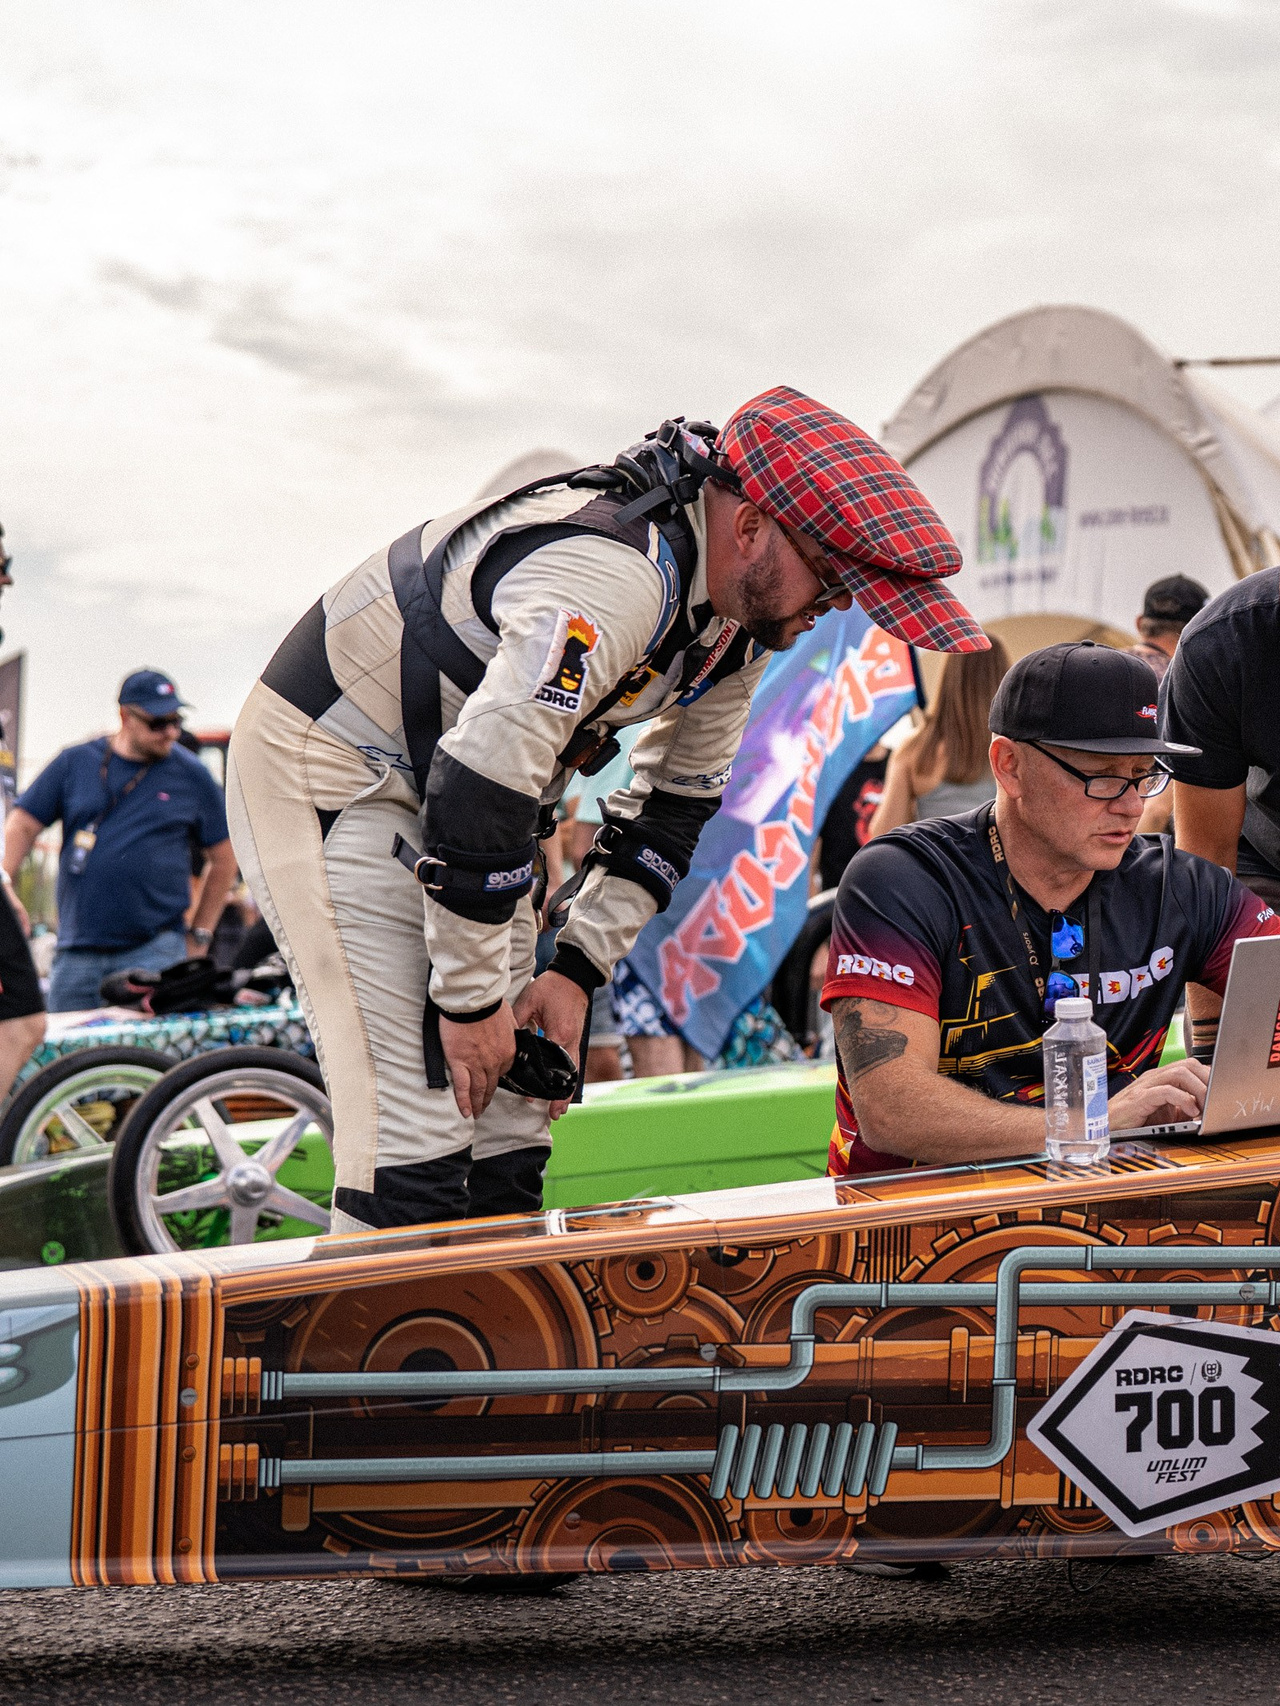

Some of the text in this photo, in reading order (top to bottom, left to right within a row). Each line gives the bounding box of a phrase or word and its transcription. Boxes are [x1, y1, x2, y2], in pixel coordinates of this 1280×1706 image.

[694, 622, 738, 685] SIMPSON
[535, 687, 579, 710] DRC
[988, 825, 1005, 863] RDRC
[836, 953, 915, 986] RDRC
[1115, 1365, 1184, 1387] RDRC
[1115, 1385, 1236, 1454] 700
[1146, 1457, 1208, 1473] UNLIM
[1154, 1469, 1201, 1485] FEST
